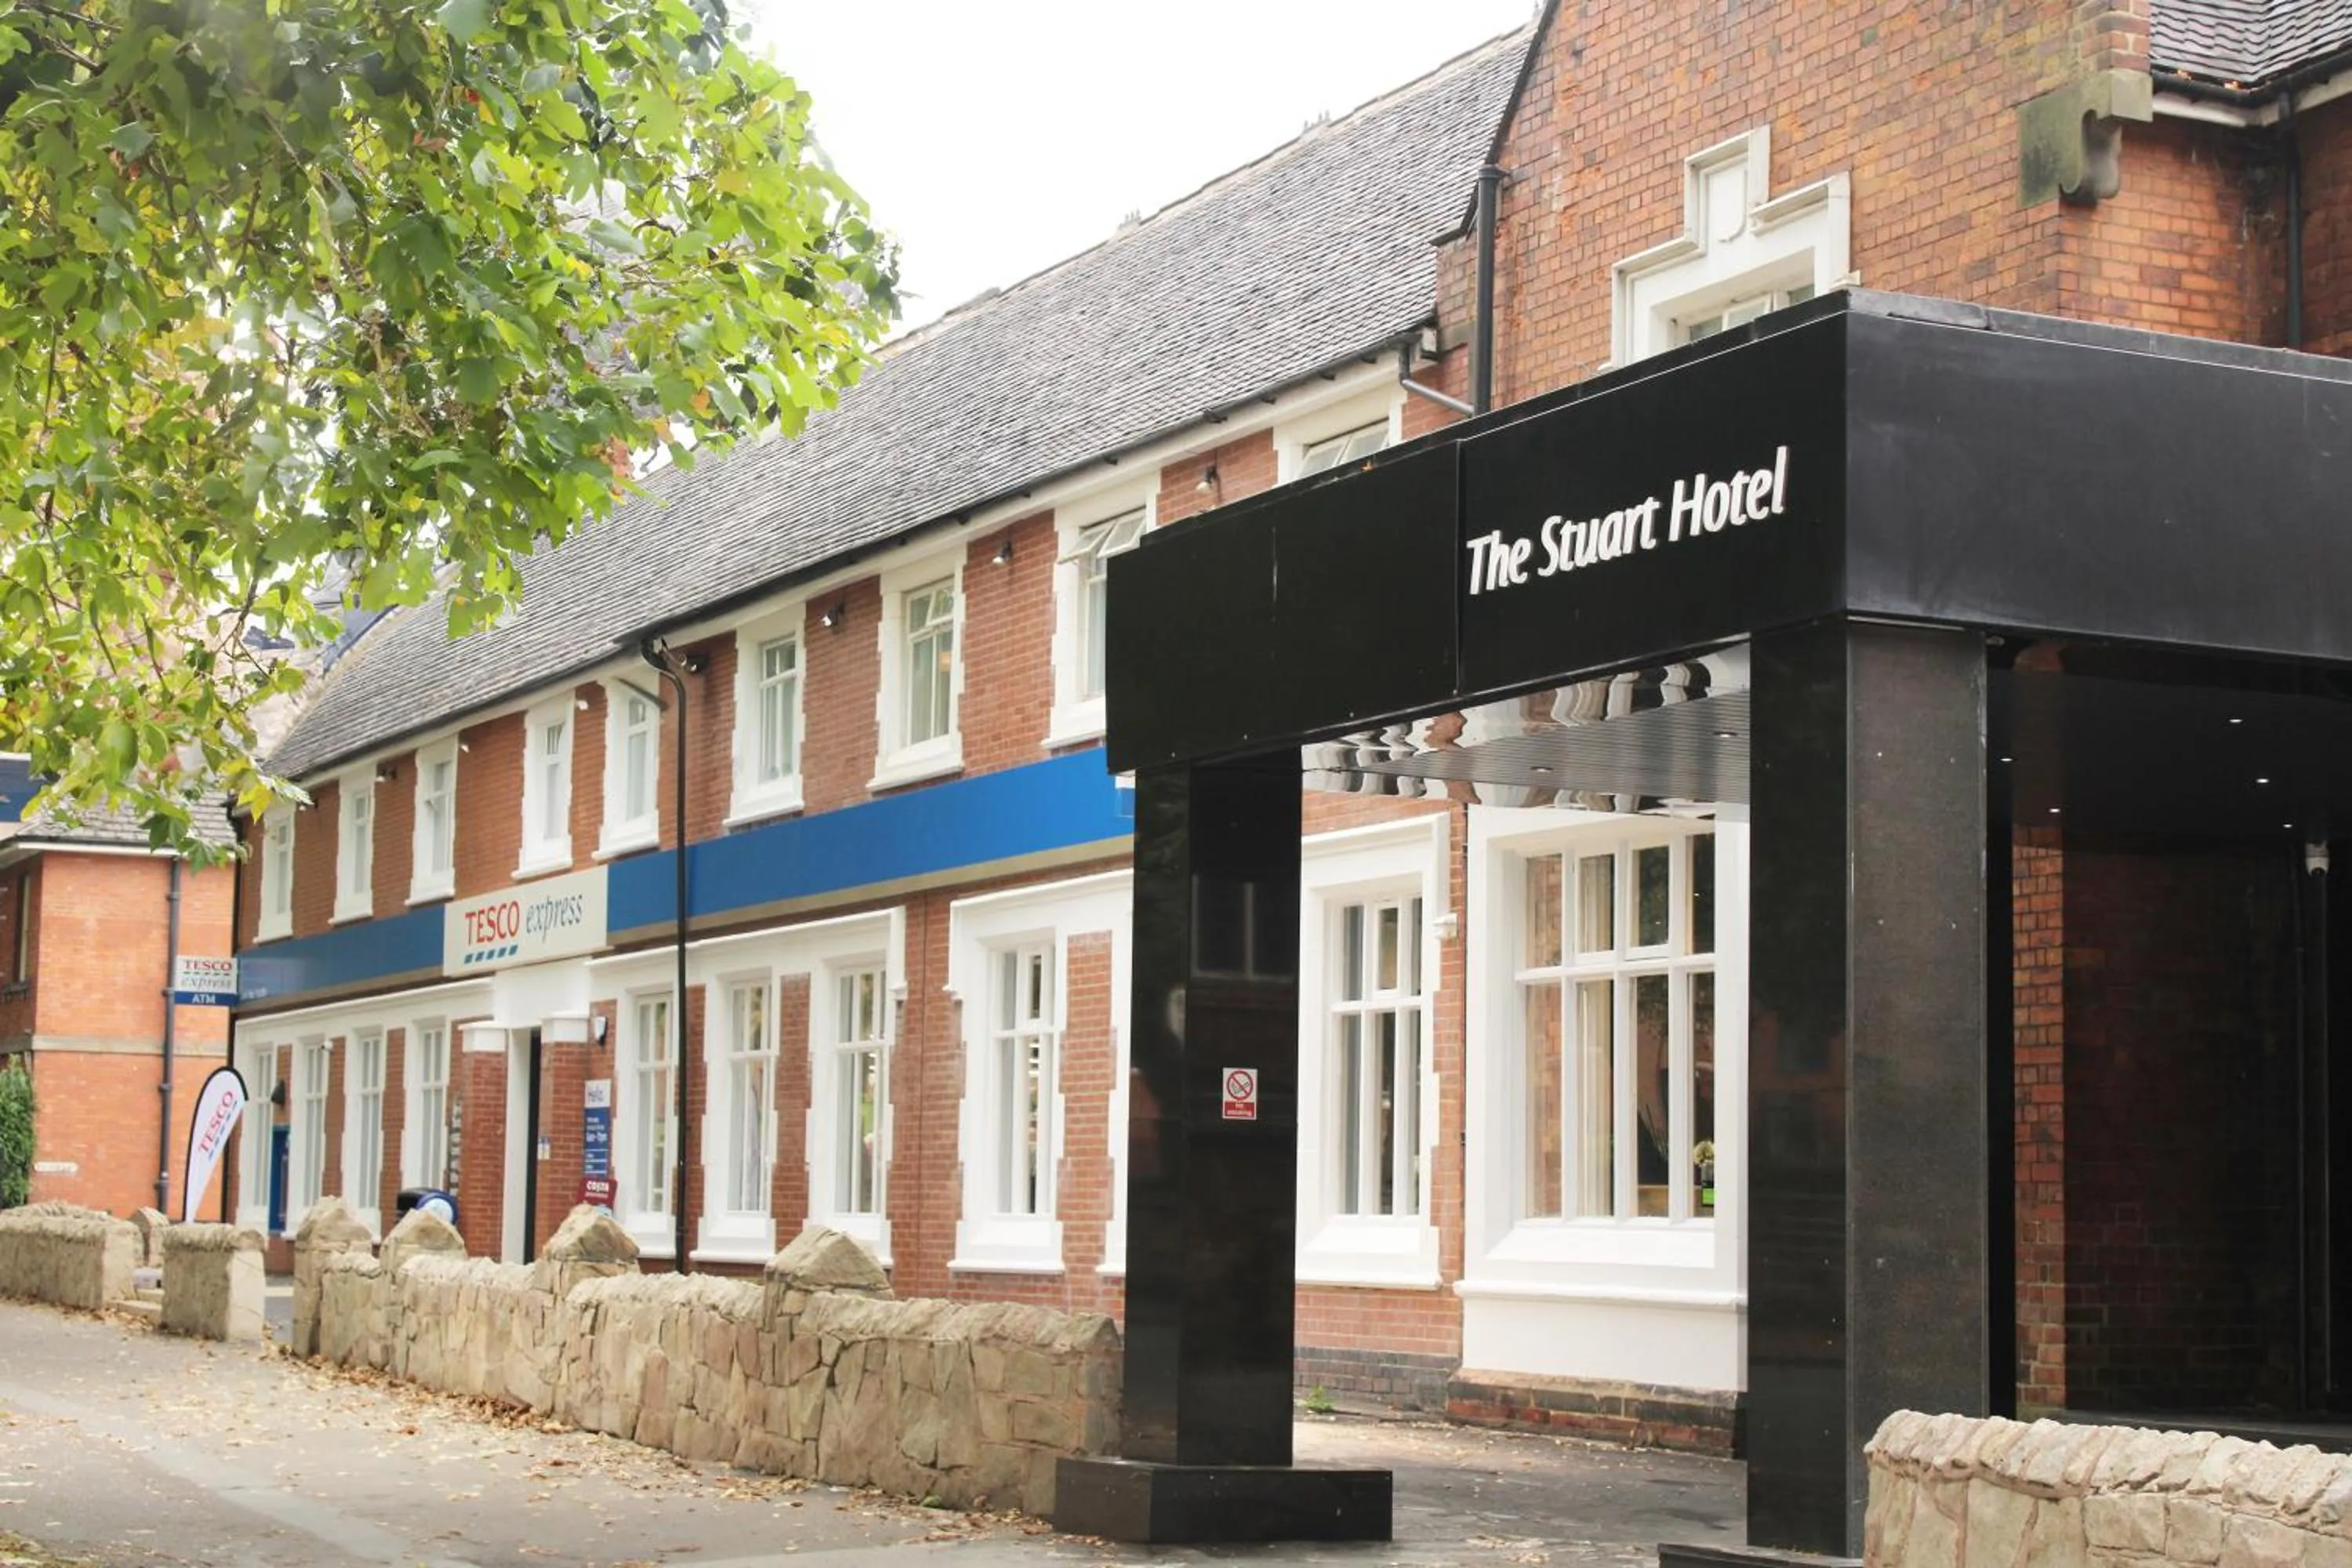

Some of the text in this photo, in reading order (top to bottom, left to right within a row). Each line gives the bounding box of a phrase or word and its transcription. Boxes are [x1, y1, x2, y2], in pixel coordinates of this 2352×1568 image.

[1467, 445, 1788, 594] The Stuart Hotel
[465, 895, 583, 947] TESCO express
[183, 960, 232, 971] TESCO
[191, 993, 216, 1004] ATM
[198, 1091, 233, 1152] TESCO
